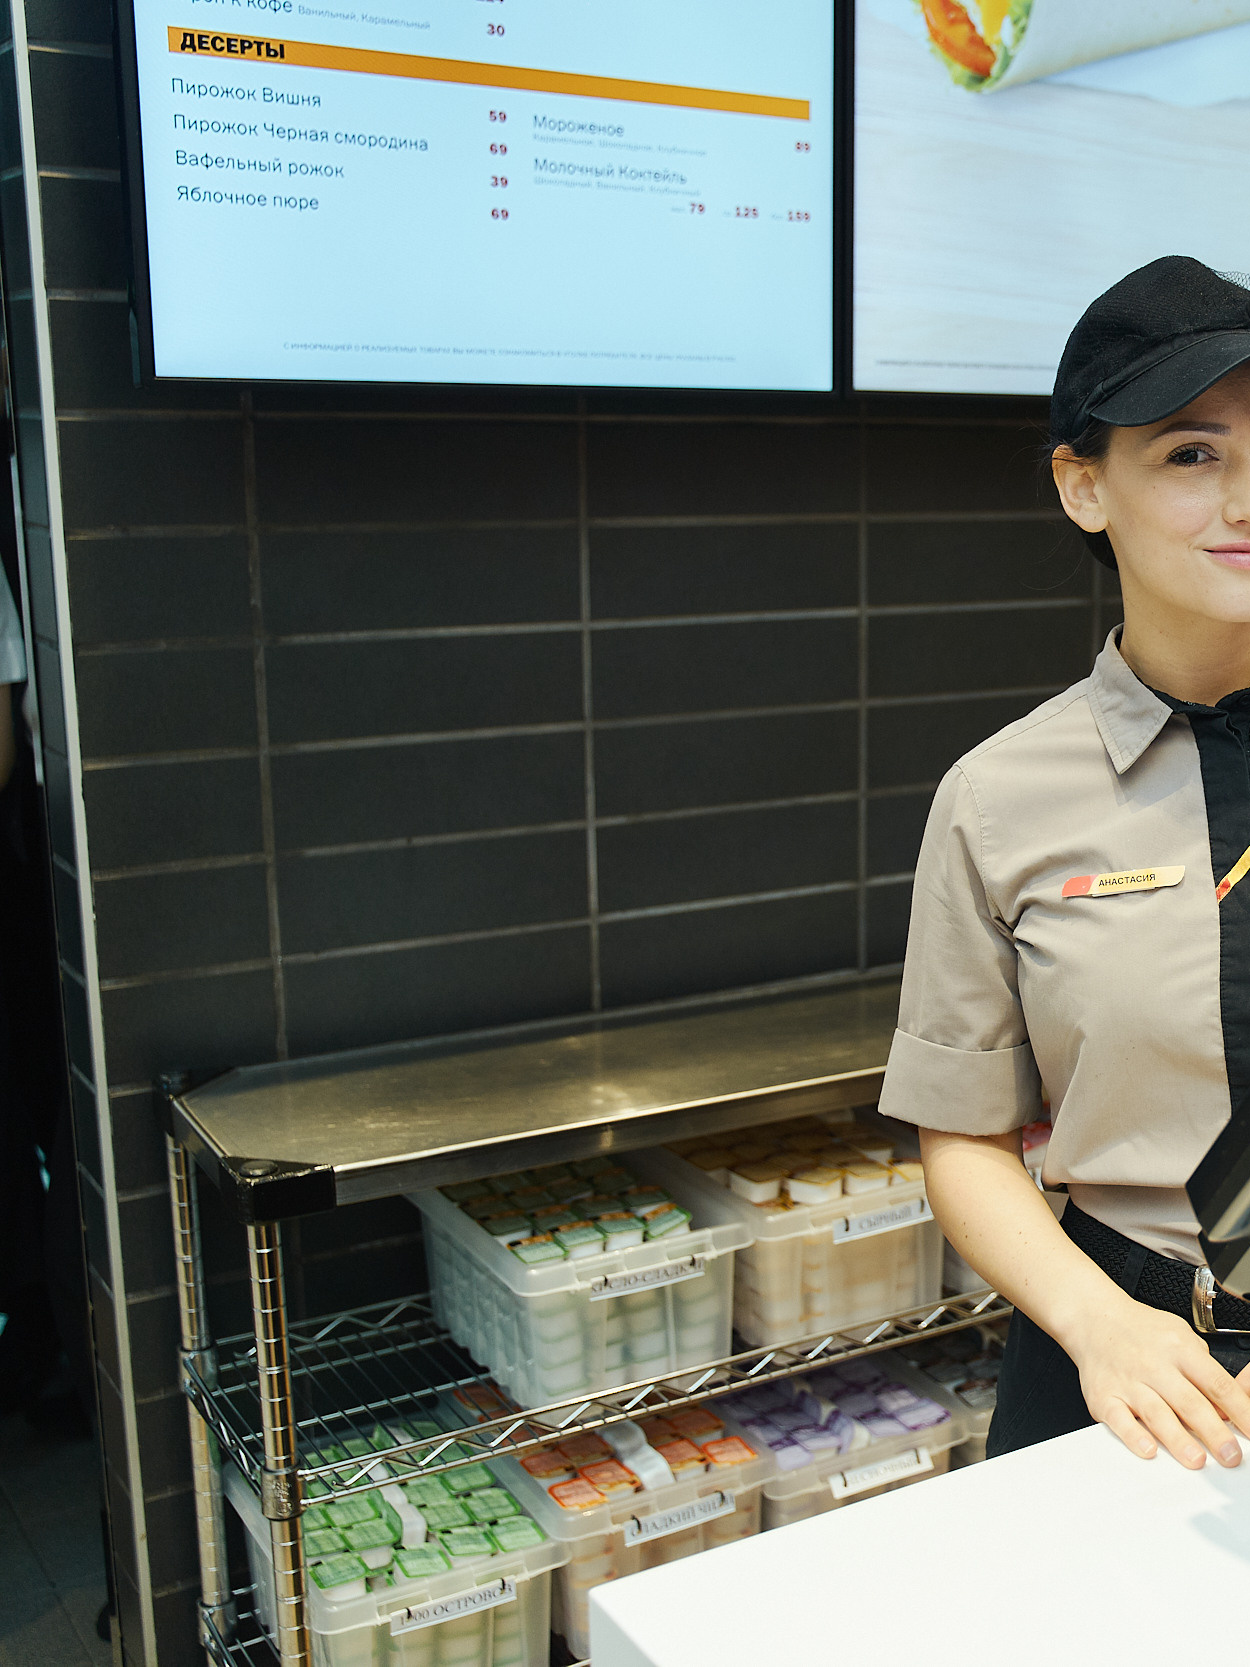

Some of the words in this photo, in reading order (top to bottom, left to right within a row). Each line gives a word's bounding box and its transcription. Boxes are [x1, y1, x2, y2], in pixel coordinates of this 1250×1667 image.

[487, 23, 506, 37] 30
[180, 32, 286, 59] ДЕСЕРТЫ
[171, 78, 257, 103] Пирожок
[262, 87, 321, 108] Вишня
[489, 110, 507, 123] 59
[533, 114, 625, 139] Мороженое
[173, 114, 259, 139] Пирожок
[263, 121, 329, 143] Черная
[334, 131, 429, 152] смородина
[490, 143, 508, 155] 69
[176, 150, 282, 173] Вафельный
[288, 162, 345, 179] рожок
[533, 157, 615, 180] Молочный
[618, 163, 688, 186] Коктейль
[491, 176, 509, 188] 39
[177, 186, 267, 206] Яблочное
[273, 194, 320, 212] пюре
[491, 208, 510, 221] 69
[1098, 873, 1156, 887] АНАСТАСИЯ
[400, 1607, 430, 1626] 100
